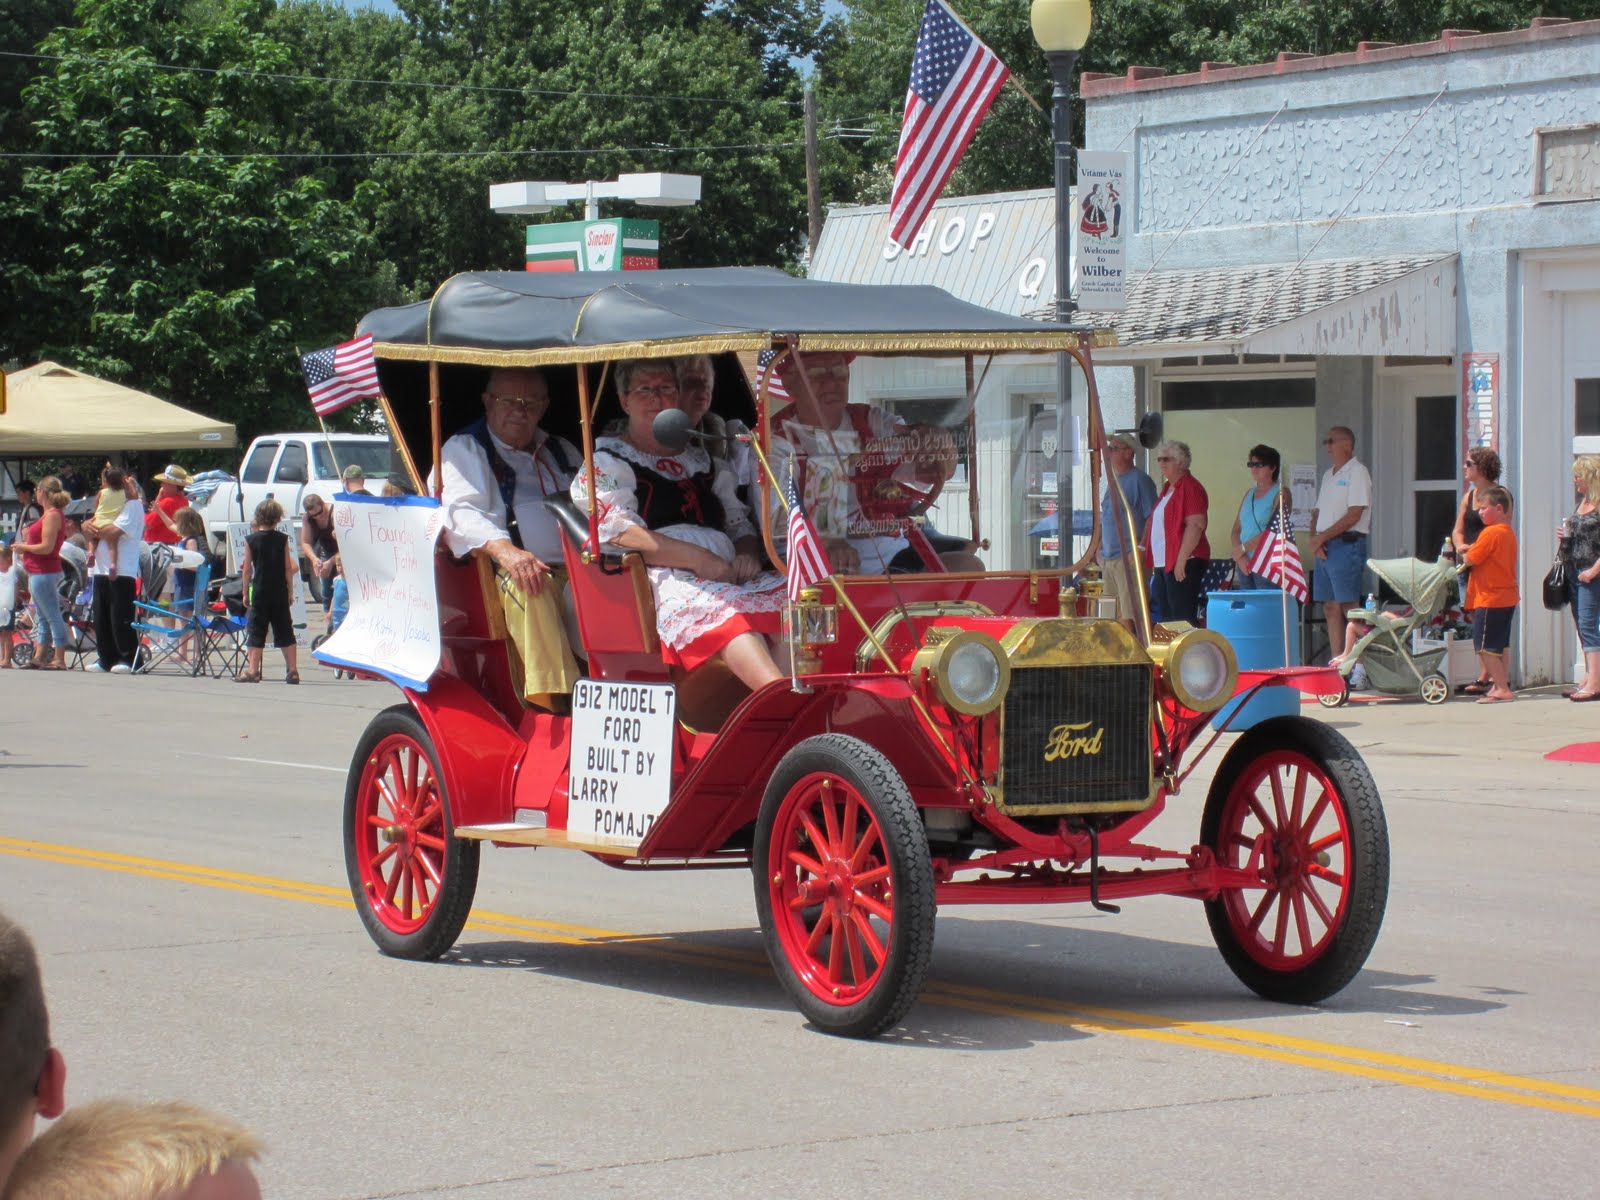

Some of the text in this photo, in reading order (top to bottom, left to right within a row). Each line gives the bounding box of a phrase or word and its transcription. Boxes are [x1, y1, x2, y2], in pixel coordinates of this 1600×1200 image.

[587, 230, 616, 247] Sinclair
[1084, 246, 1120, 255] Welcome
[1082, 265, 1122, 277] Wilber
[574, 684, 673, 715] 1912 MODEL T
[603, 716, 641, 743] FORD
[1044, 721, 1104, 762] Ford
[587, 746, 655, 776] BUILT BY
[571, 776, 618, 804] LARRY
[594, 808, 660, 838] POMAJZ
